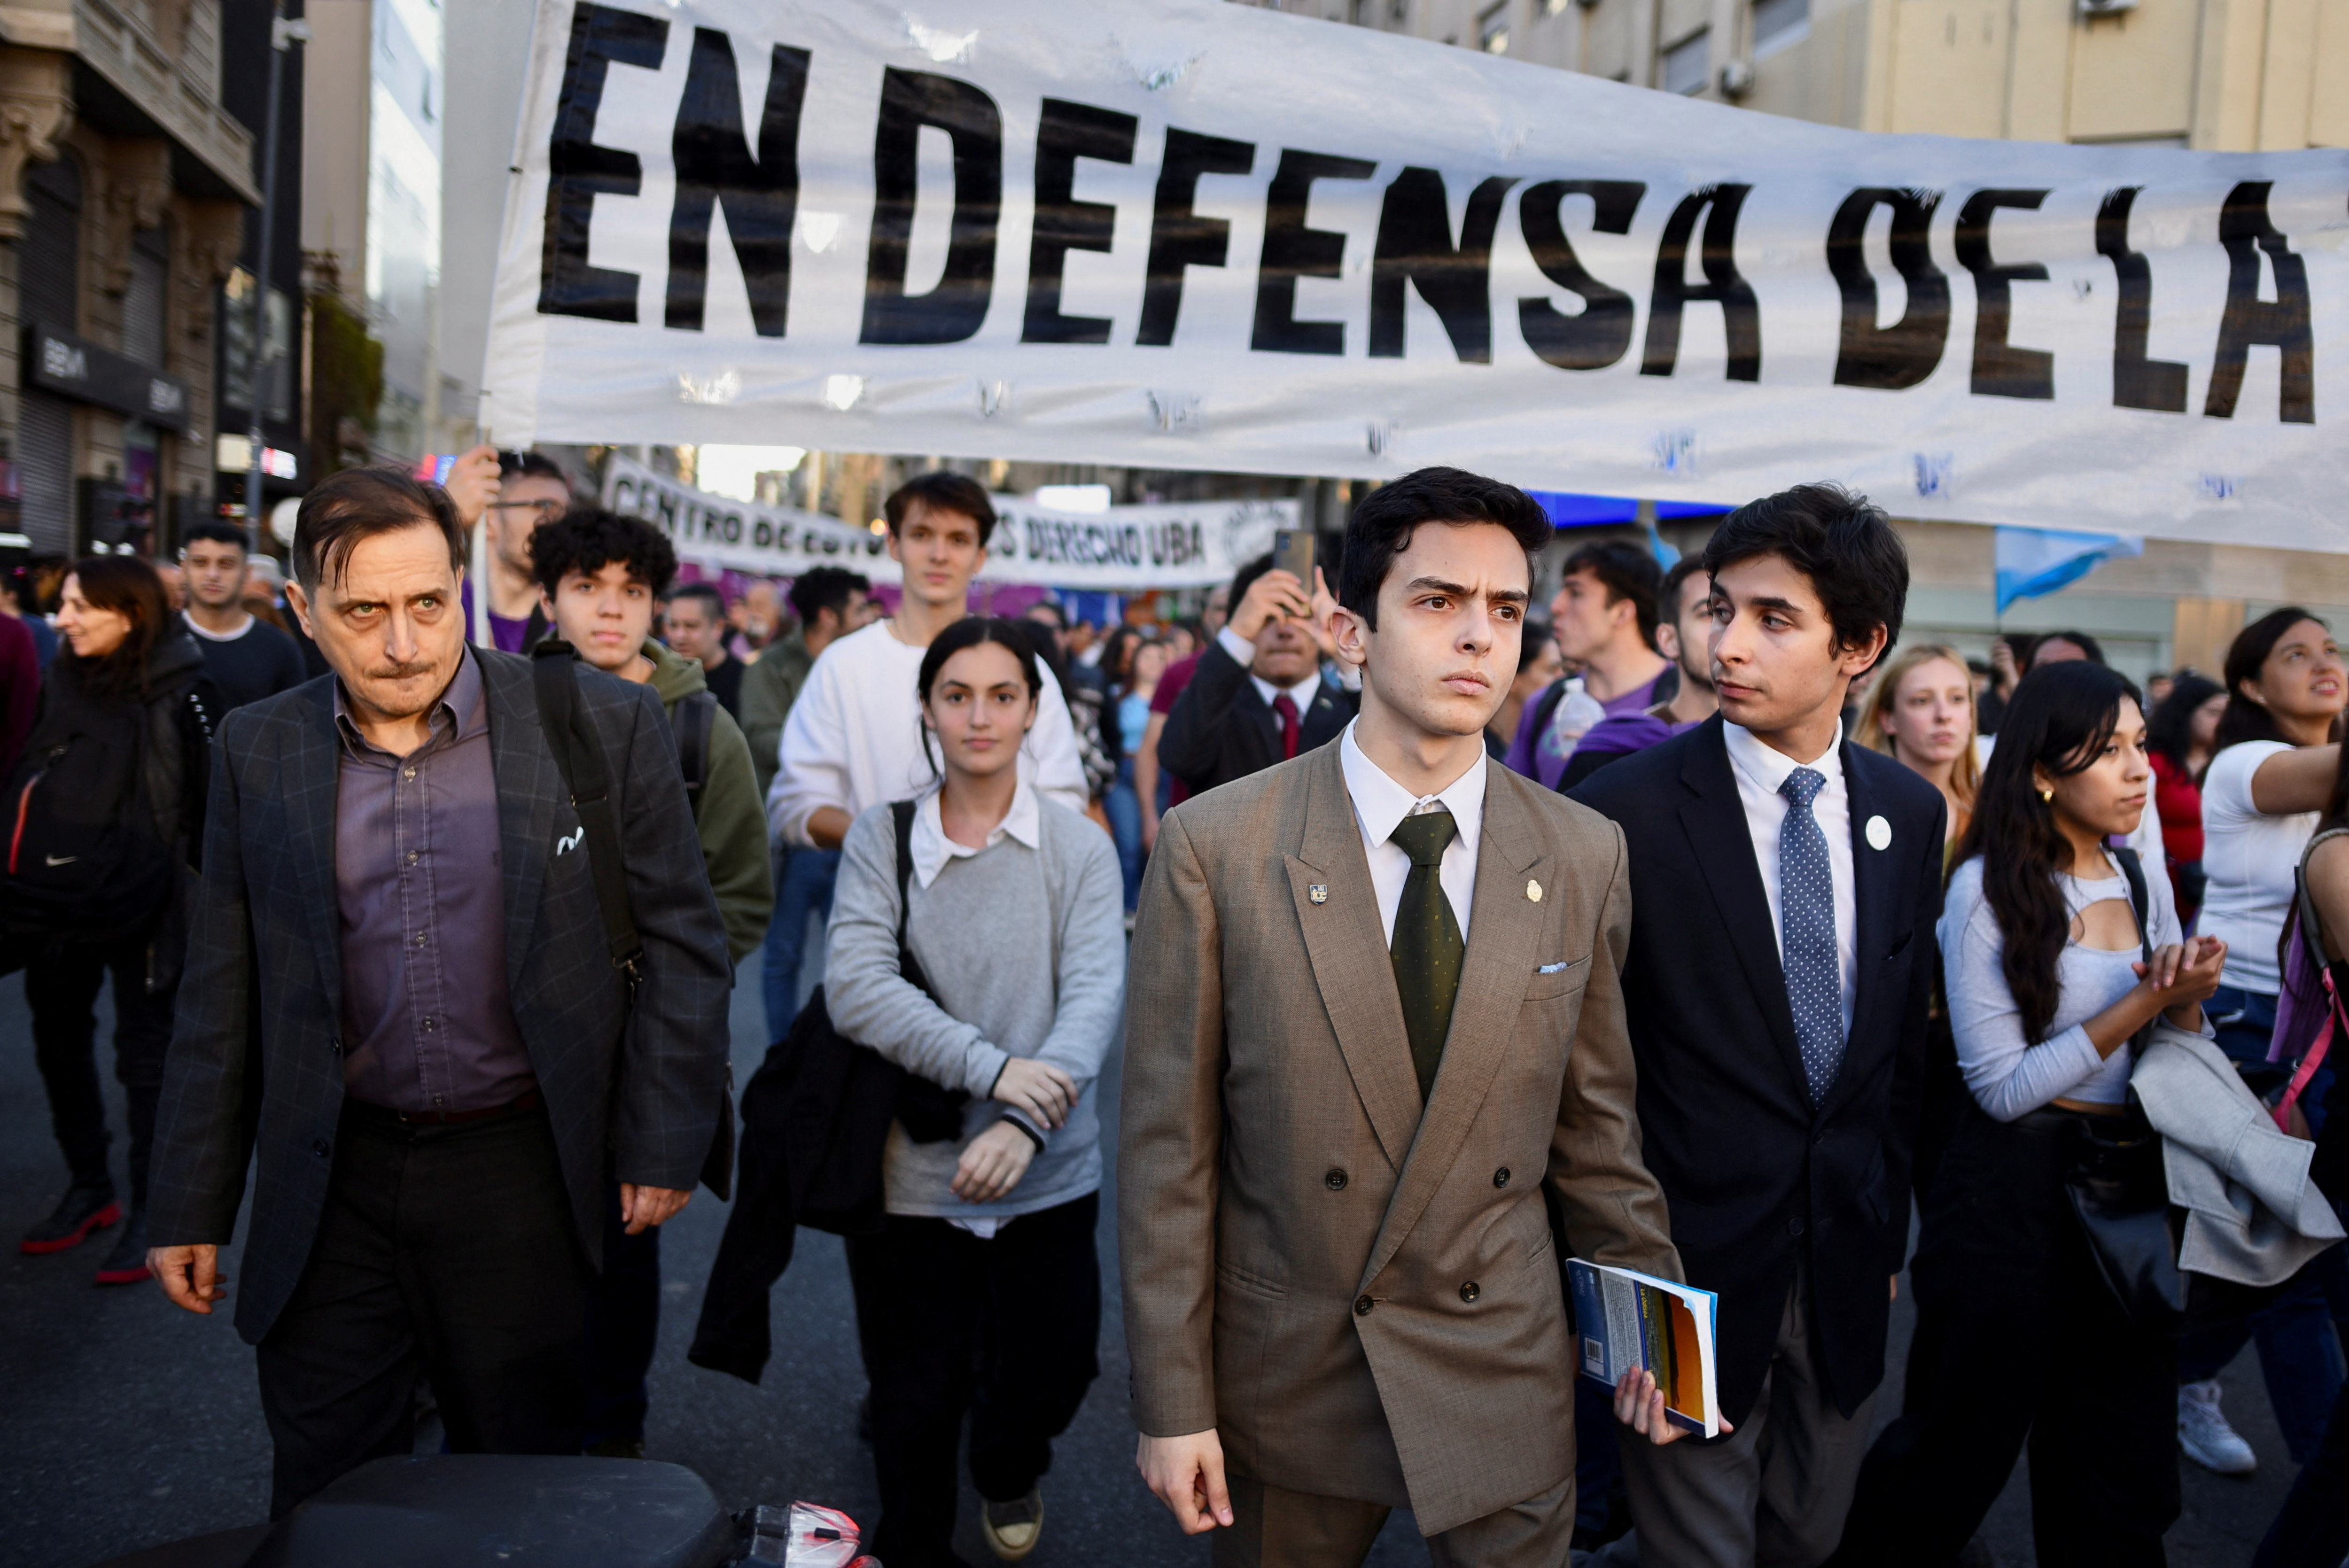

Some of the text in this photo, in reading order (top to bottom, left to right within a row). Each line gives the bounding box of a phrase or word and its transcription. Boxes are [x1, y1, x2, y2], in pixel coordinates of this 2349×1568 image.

[536, 1, 2316, 425] EN DEFENSA DE LA
[614, 479, 741, 543] CENTRO
[754, 520, 793, 551] DE
[1027, 518, 1142, 567] DERECHO
[1152, 521, 1206, 565] UBA
